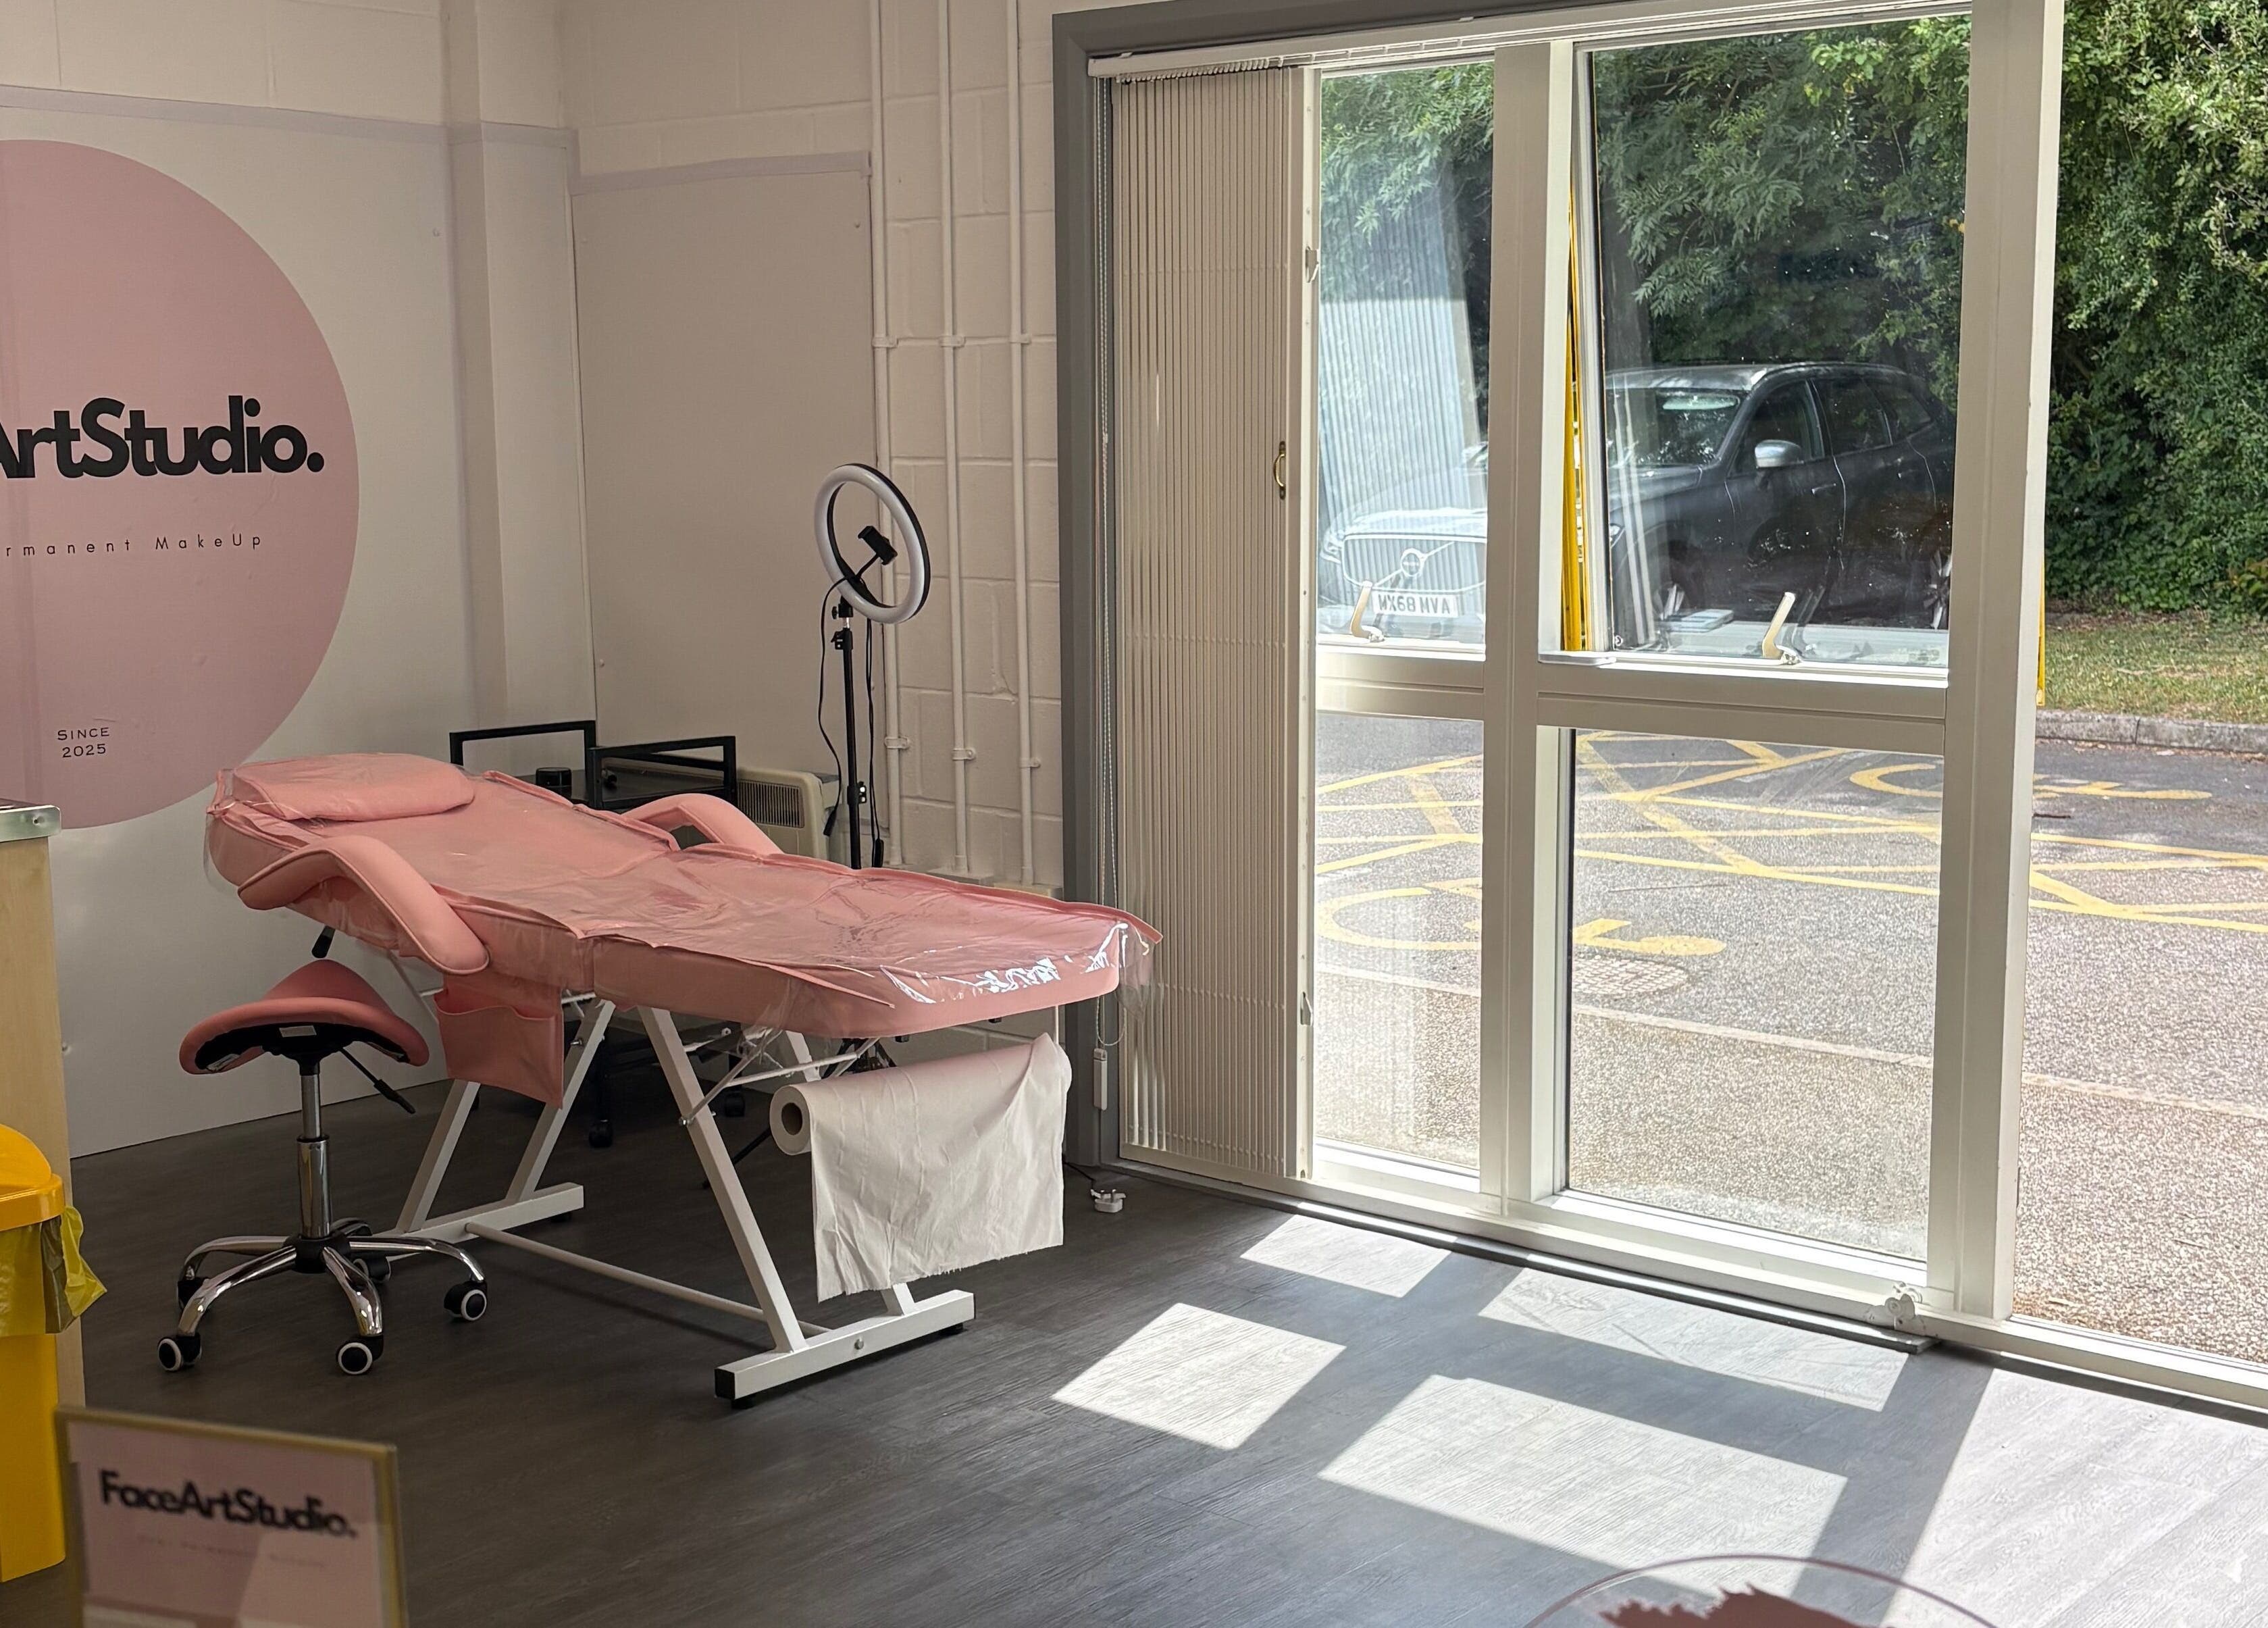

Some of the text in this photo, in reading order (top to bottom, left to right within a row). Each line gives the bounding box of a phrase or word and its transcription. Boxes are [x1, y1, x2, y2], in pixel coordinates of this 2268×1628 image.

[155, 533, 261, 550] MakeUp
[57, 727, 110, 740] SINCE
[61, 743, 107, 759] 2025
